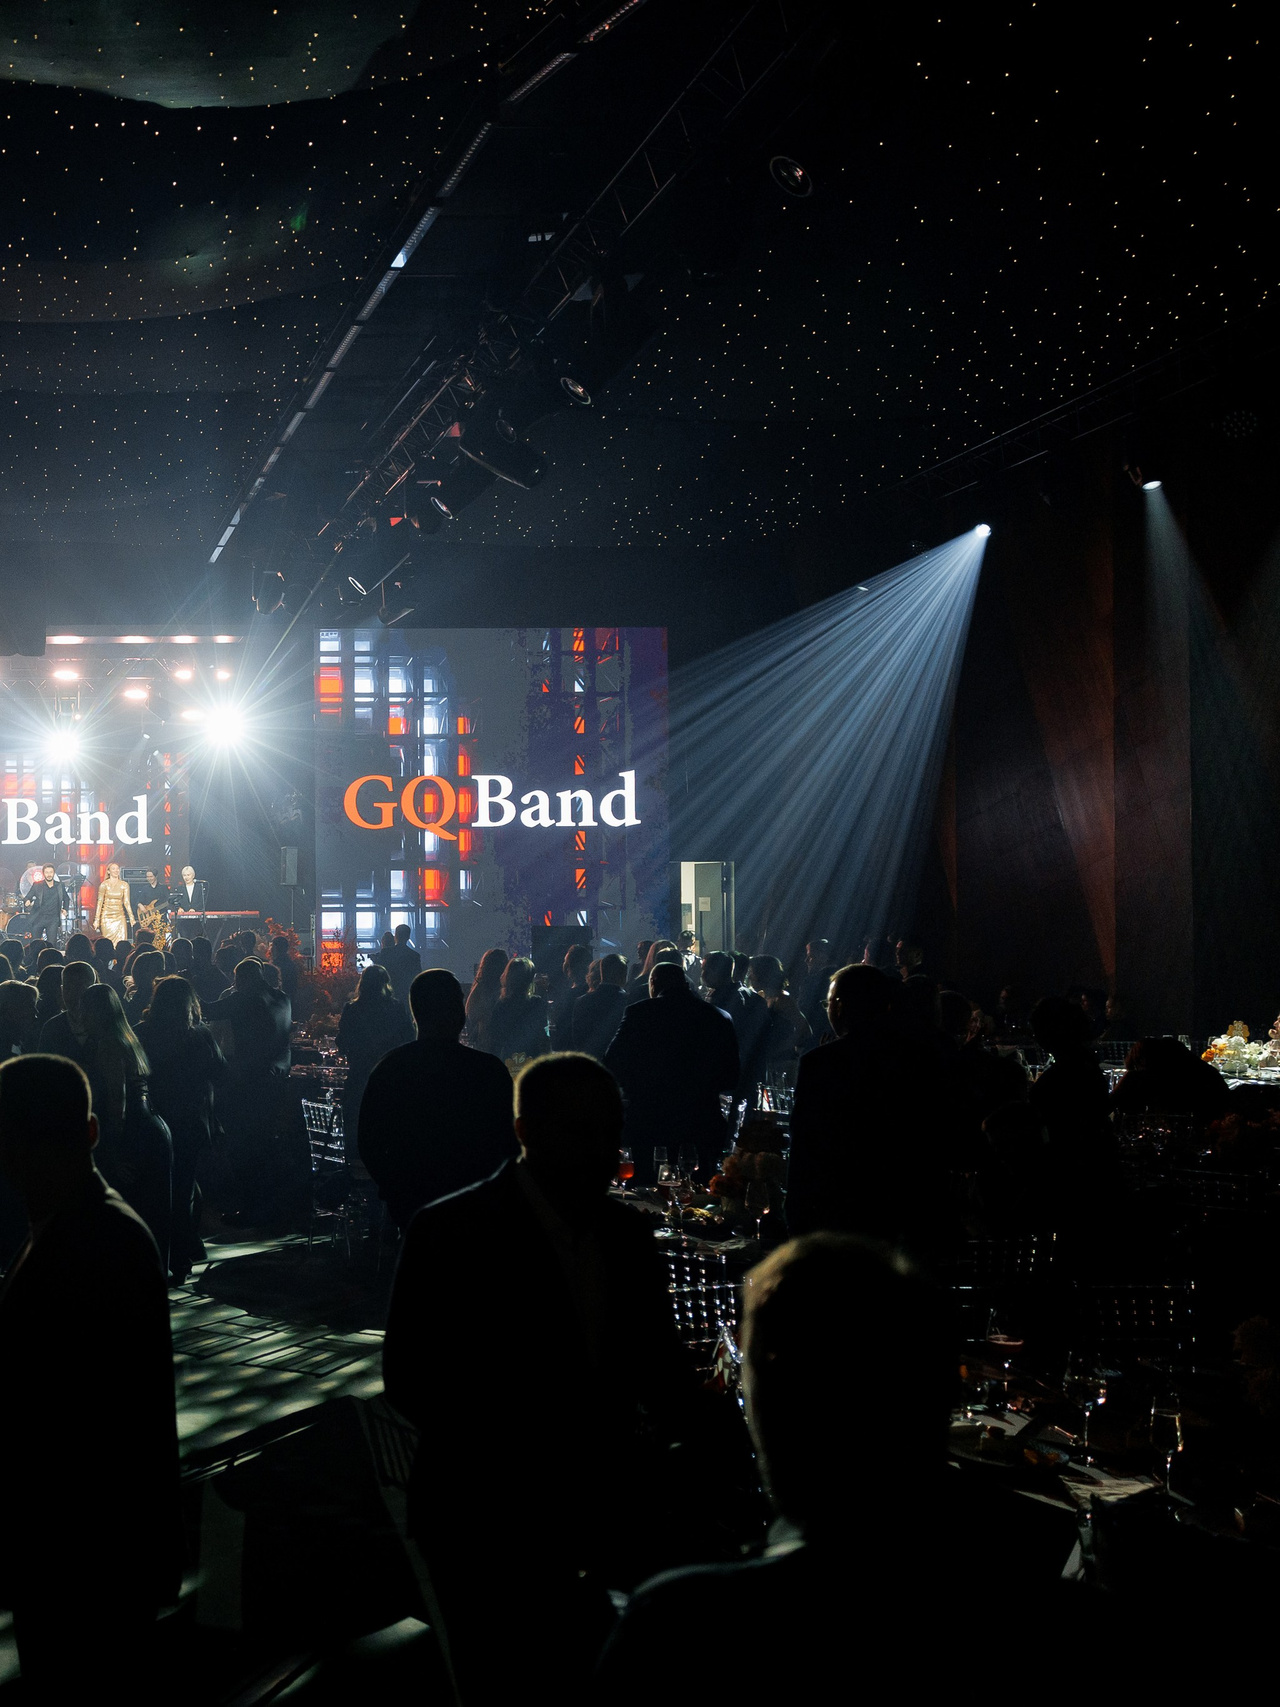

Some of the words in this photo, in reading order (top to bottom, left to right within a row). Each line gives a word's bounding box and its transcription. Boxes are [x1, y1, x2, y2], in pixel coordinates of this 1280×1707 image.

[1, 793, 153, 846] Band
[343, 774, 458, 841] GQ
[471, 769, 642, 828] Band
